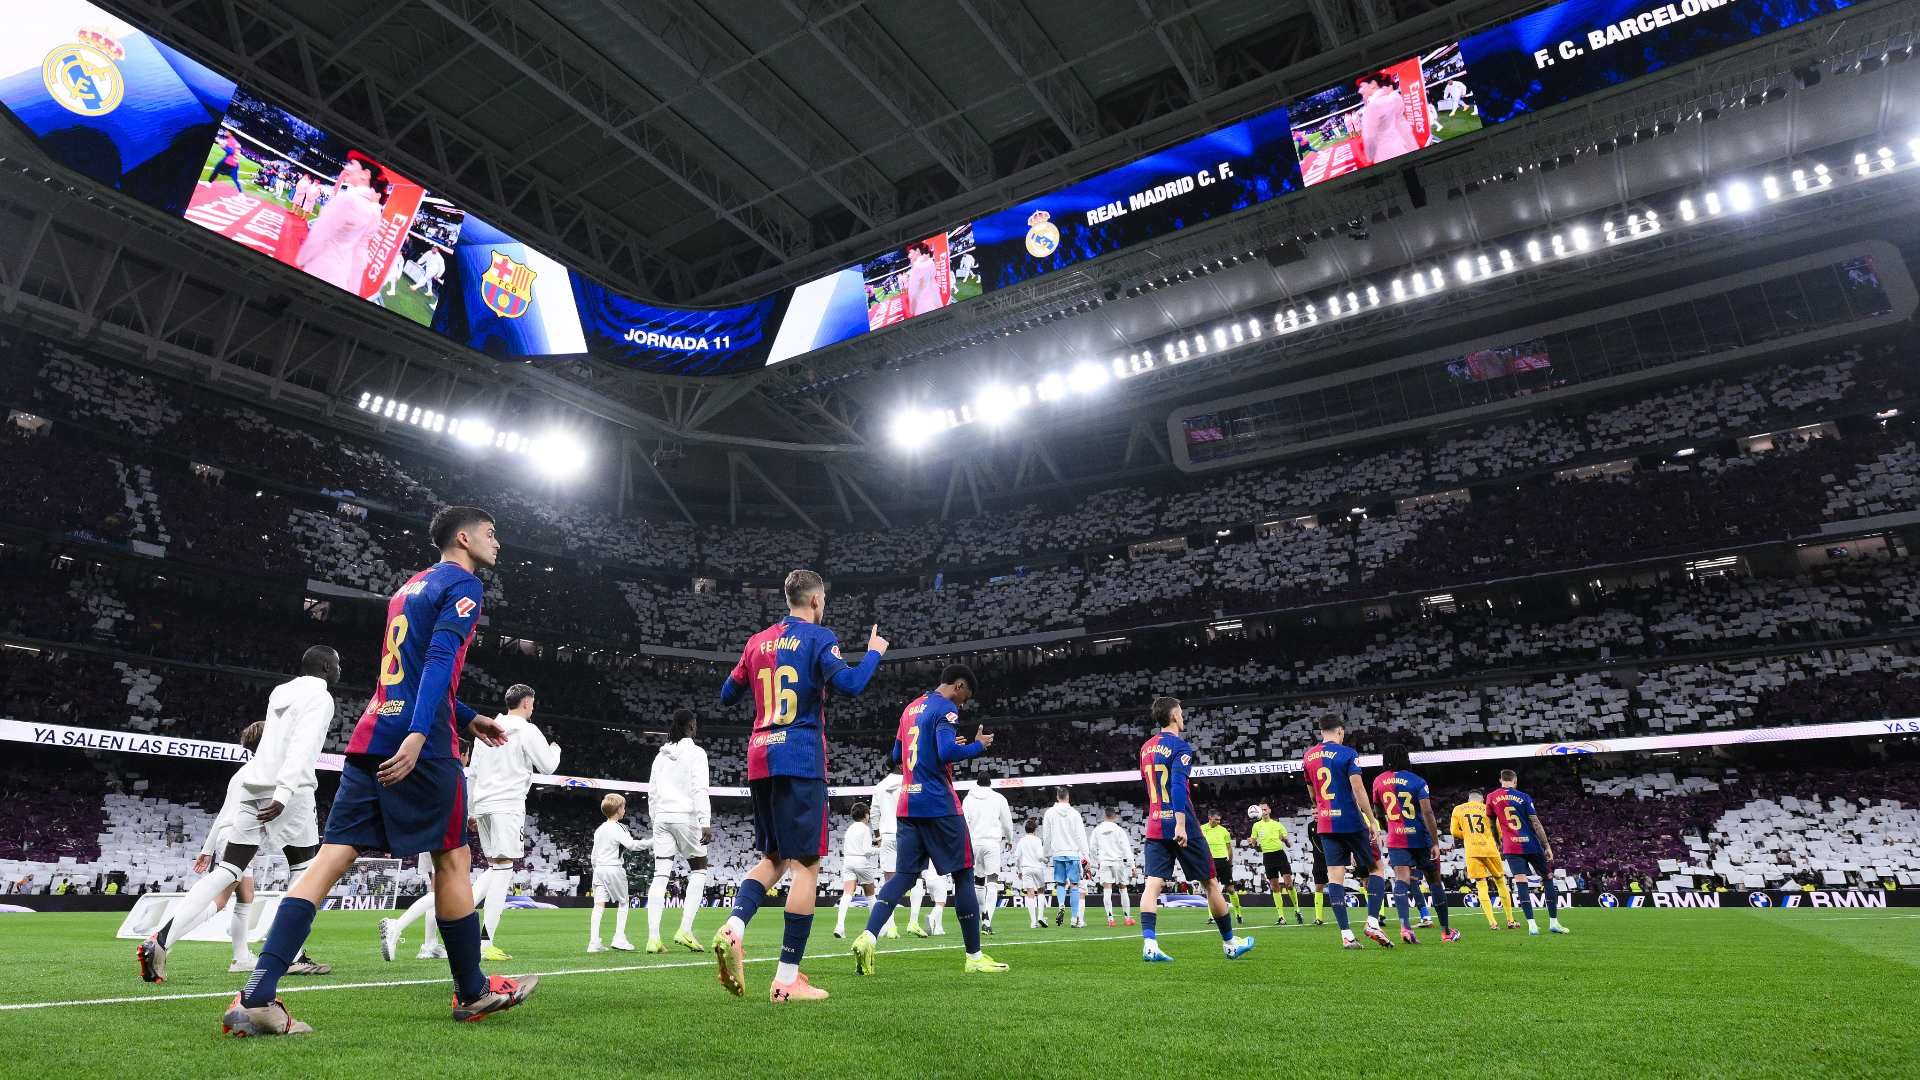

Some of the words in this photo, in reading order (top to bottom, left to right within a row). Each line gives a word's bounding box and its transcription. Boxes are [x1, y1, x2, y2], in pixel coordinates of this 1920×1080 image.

[1534, 49, 1554, 69] F.
[1558, 40, 1584, 60] C.
[1588, 0, 1736, 50] BARCELON
[1087, 200, 1127, 227] REAL
[1129, 176, 1194, 212] MADRID
[1198, 168, 1216, 187] C.
[1218, 162, 1234, 180] F.
[368, 213, 409, 284] Emirates
[624, 328, 709, 350] JORNADA
[713, 336, 731, 349] 11
[380, 614, 409, 687] 8
[760, 635, 801, 655] FERMÍN
[757, 665, 799, 729] 16
[34, 727, 56, 744] YA
[62, 731, 124, 751] SALEN
[128, 737, 162, 754] LAS
[1883, 722, 1905, 732] YA
[906, 725, 920, 771] 3
[1193, 768, 1205, 777] YA
[1207, 766, 1237, 776] SALEN
[1240, 764, 1257, 774] LAS
[1259, 761, 1305, 773] ESTRELLA
[1144, 764, 1169, 804] 17
[1316, 767, 1335, 800] 2
[1382, 791, 1416, 820] 23
[1503, 806, 1522, 831] 5
[1464, 813, 1485, 833] 13
[1653, 892, 1720, 907] BMW
[1809, 888, 1887, 907] BMW
